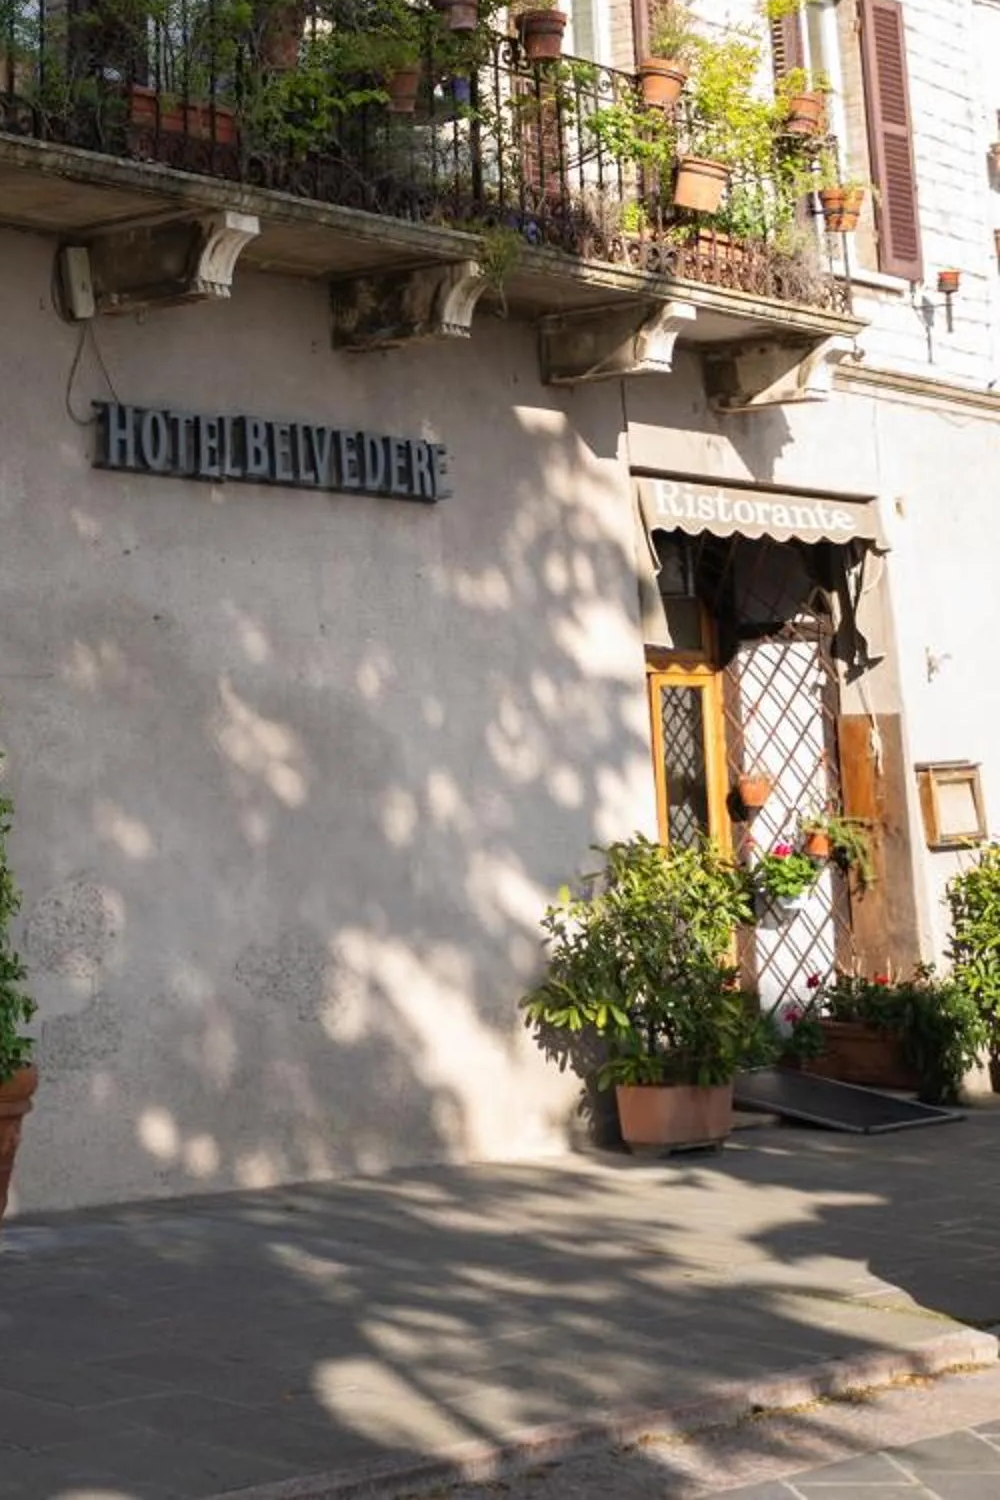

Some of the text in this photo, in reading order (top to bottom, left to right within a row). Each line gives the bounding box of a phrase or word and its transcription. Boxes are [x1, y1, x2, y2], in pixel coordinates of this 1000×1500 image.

[107, 402, 453, 500] HOTEL BELVEDERE
[653, 481, 856, 531] Ristorante
